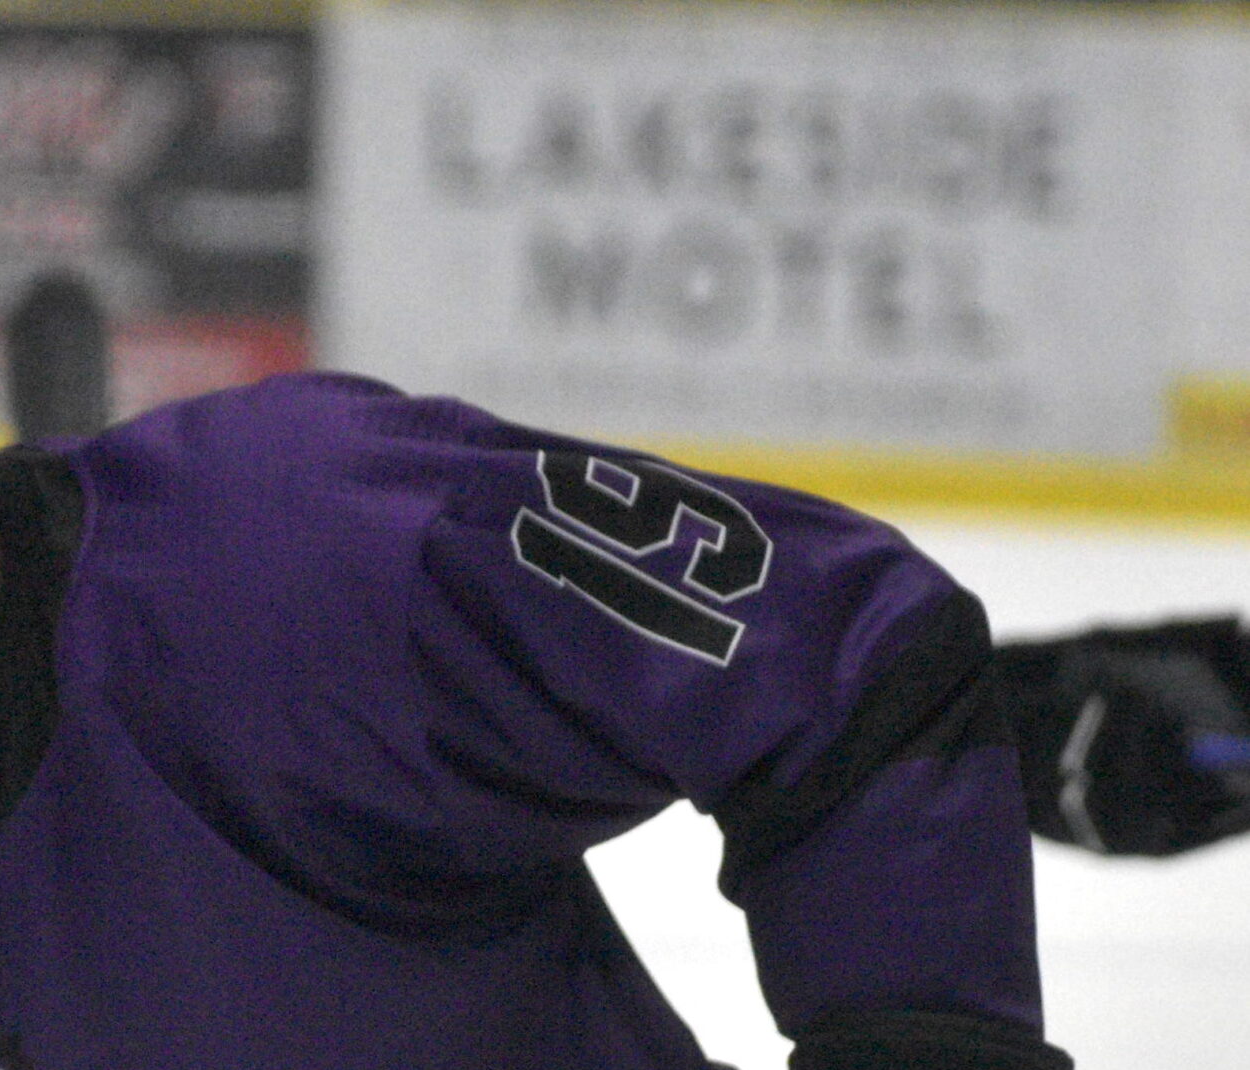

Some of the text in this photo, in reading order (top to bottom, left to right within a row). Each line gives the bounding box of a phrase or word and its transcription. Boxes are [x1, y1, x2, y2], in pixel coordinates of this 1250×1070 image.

[421, 74, 1074, 224] LAKESIDE
[525, 222, 1005, 359] MOTEL
[511, 448, 772, 667] 19
